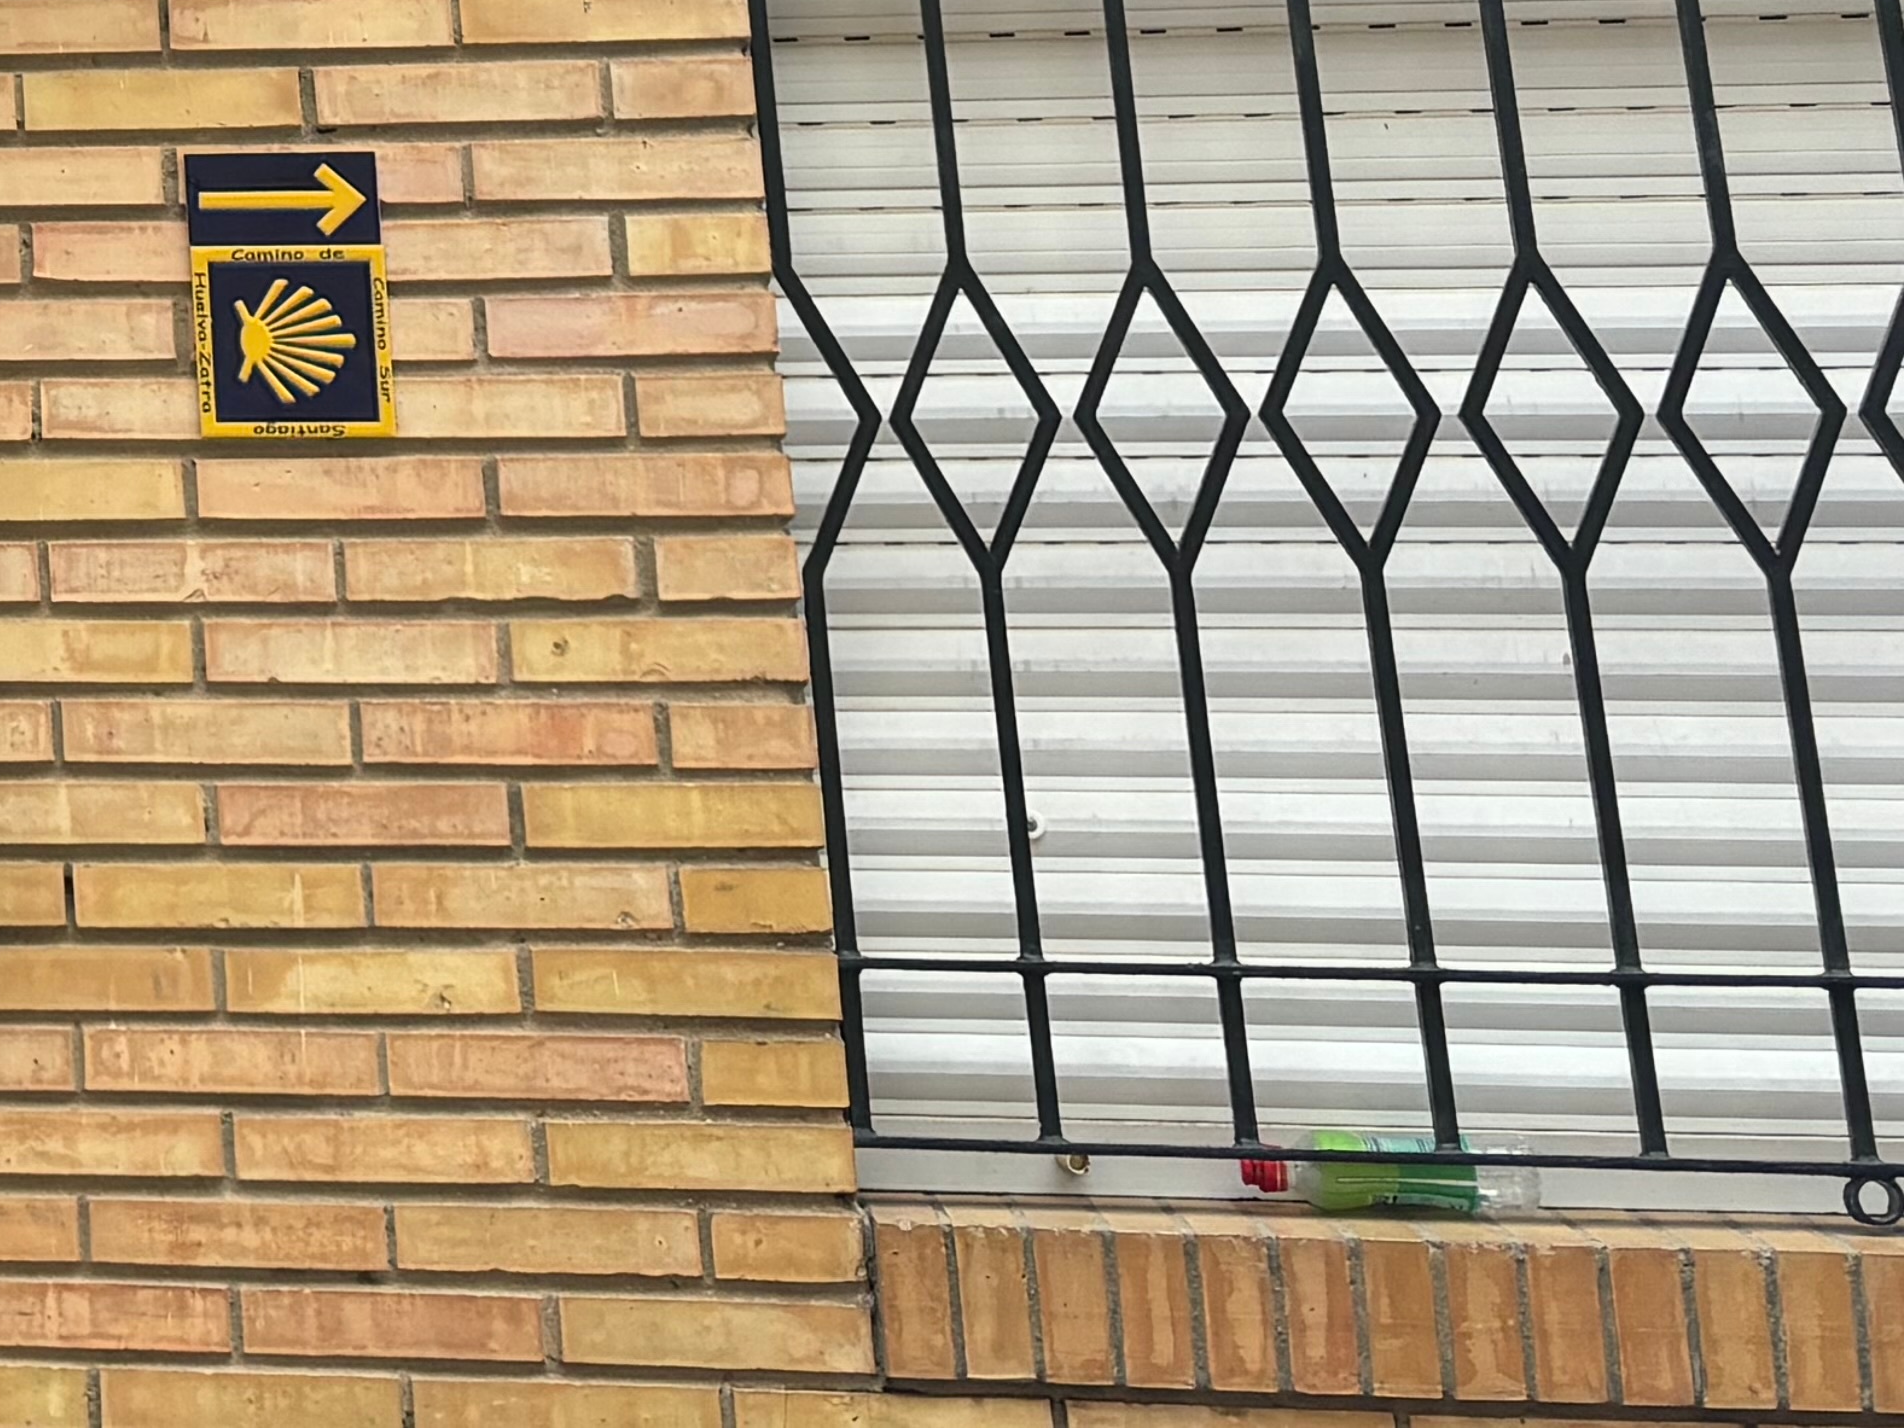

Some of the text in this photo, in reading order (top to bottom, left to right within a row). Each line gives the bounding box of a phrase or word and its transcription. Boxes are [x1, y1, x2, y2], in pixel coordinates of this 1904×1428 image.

[231, 247, 346, 263] Camino de
[194, 271, 213, 414] Huelva-Zafra
[373, 277, 391, 404] Camino Sur
[253, 421, 347, 437] Santiago
